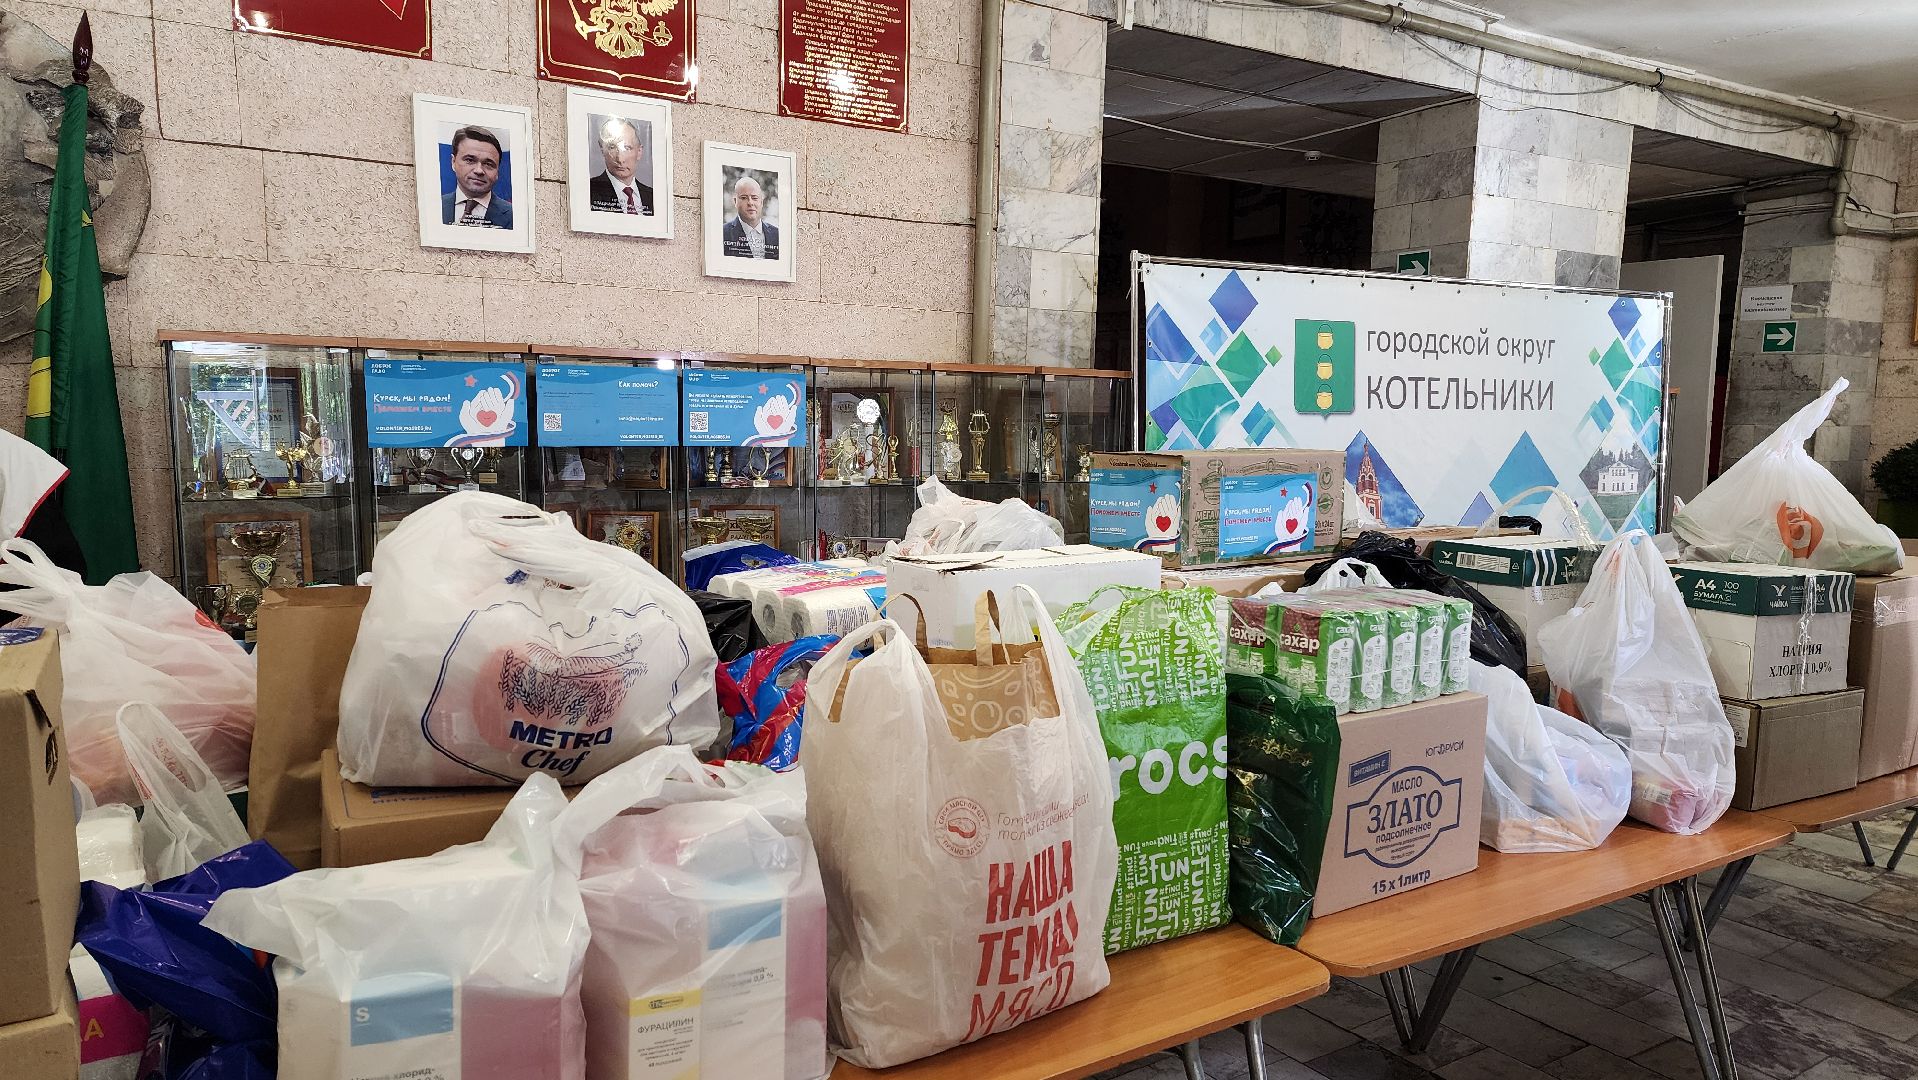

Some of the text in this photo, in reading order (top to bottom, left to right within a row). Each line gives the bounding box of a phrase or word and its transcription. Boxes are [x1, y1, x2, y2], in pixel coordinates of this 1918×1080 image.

[1368, 328, 1556, 364] городской округ
[1367, 375, 1554, 410] КОТЕЛЬНИКИ
[1694, 590, 1723, 600] БУМАГА
[1230, 627, 1266, 645] сахар
[1279, 633, 1320, 653] сахар
[1782, 643, 1822, 657] НАТРИЯ
[509, 721, 612, 750] METRO
[521, 749, 591, 777] Chef
[1392, 776, 1423, 794] МАСЛО
[1367, 790, 1443, 833] ЗЛАТО
[1375, 821, 1432, 844] подсолнечное
[1191, 841, 1211, 857] FUN
[986, 840, 1074, 924] НАША
[1135, 853, 1148, 887] FUN
[1149, 852, 1190, 884] FUN
[1191, 854, 1210, 905] FUN
[1372, 880, 1387, 894] 15
[1136, 888, 1157, 939] FUN
[356, 1007, 370, 1022] S
[960, 960, 1075, 1042] МЯСО
[637, 1016, 694, 1033] ФУРАЦИЛИН
